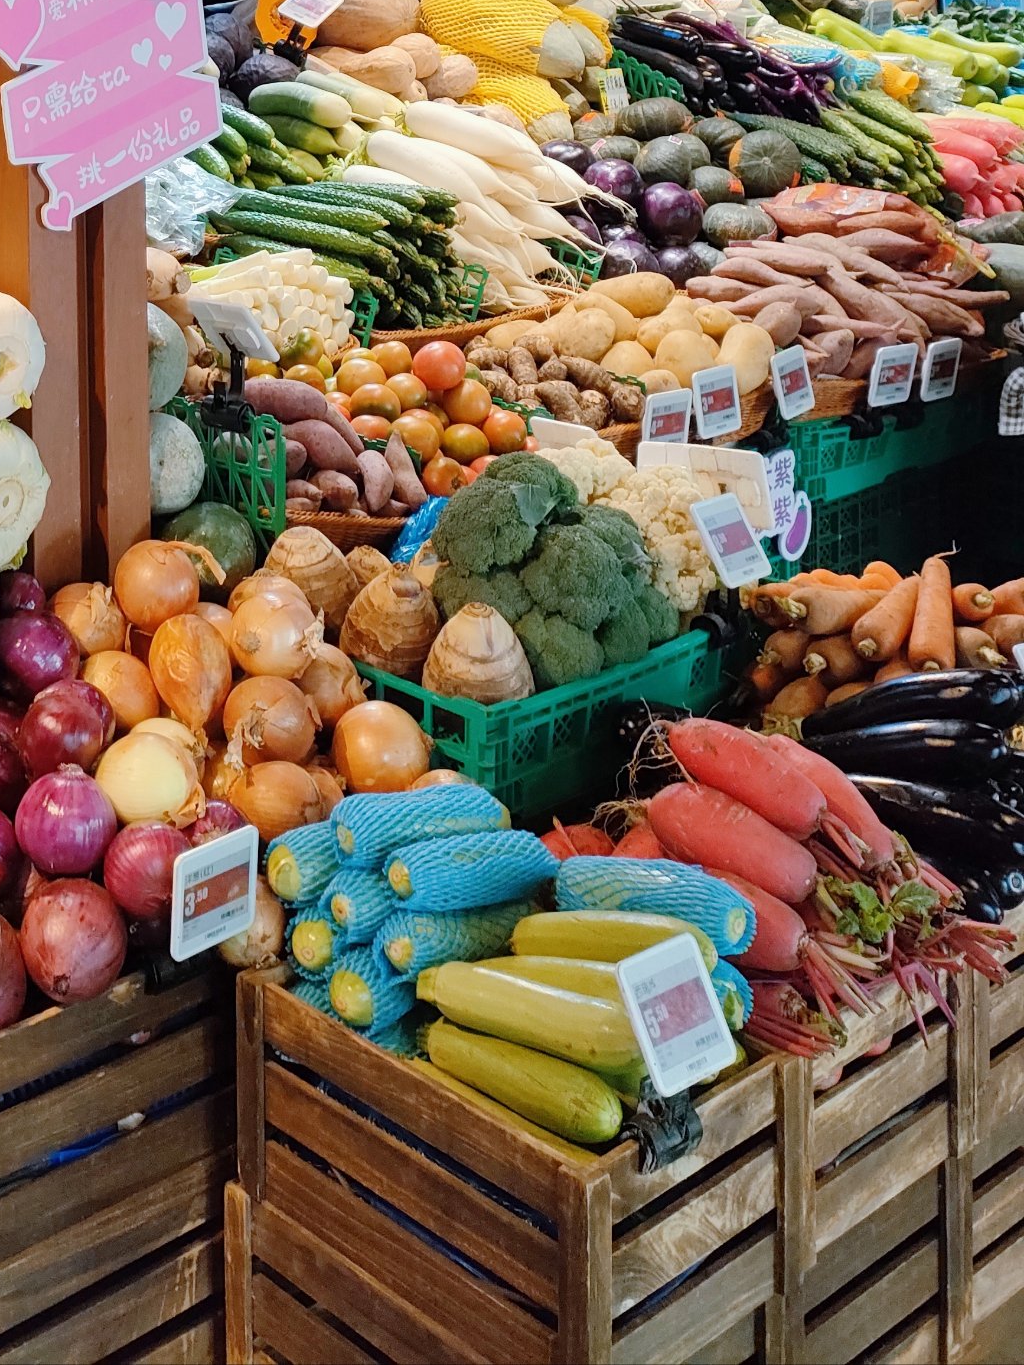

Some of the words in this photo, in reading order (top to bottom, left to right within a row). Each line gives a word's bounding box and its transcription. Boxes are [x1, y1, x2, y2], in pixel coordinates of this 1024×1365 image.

[76, 107, 201, 189] 挑一份礼品
